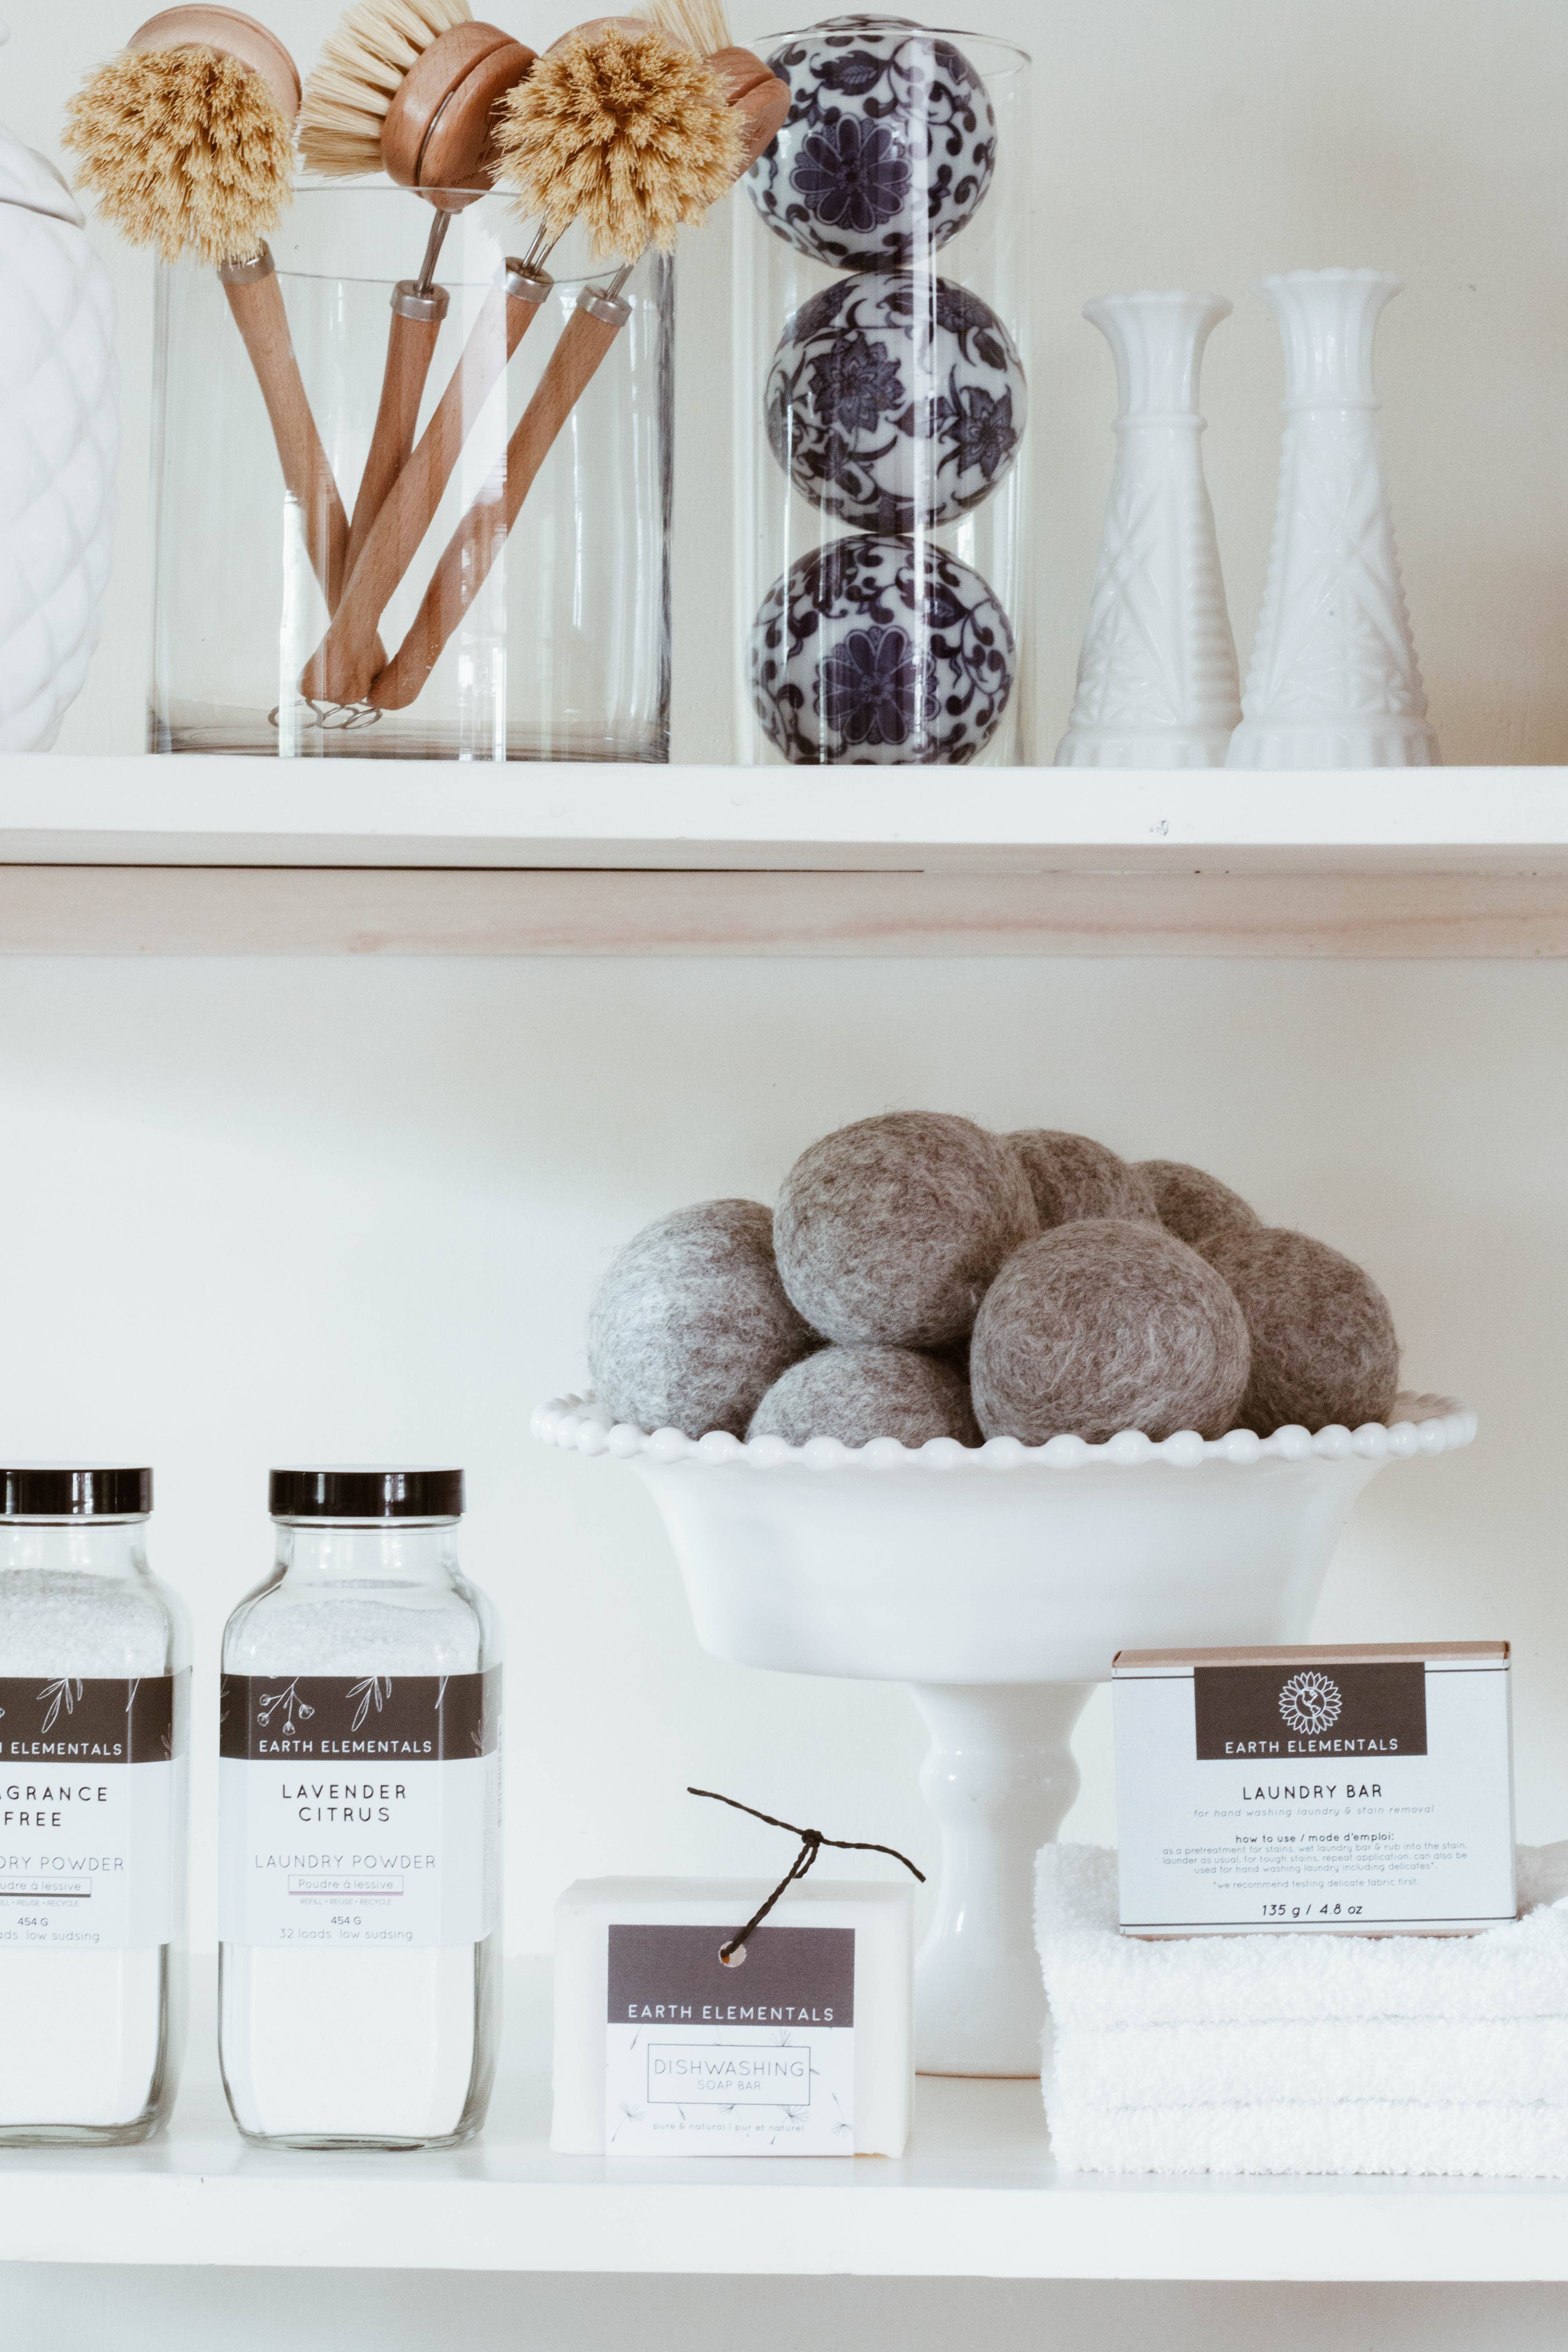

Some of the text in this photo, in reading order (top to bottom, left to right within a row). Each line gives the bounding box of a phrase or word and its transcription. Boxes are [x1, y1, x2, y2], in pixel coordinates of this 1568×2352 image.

[11, 1742, 122, 1755] ELEMENTALS
[260, 1740, 432, 1753] EARTH ELEMENTALS
[1225, 1739, 1397, 1753] EARTH ELEMENTALS
[283, 1784, 405, 1799] LAVENDER
[1243, 1784, 1381, 1800] LAUNDRY BAR
[299, 1807, 389, 1822] CITRUS
[1246, 1808, 1292, 1818] washing
[1297, 1807, 1339, 1817] laundry
[1357, 1806, 1384, 1815] stain
[1389, 1805, 1434, 1813] removal
[5, 1811, 61, 1826] FREE
[1308, 1833, 1339, 1842] mode
[1344, 1832, 1394, 1842] d'emploi:
[1185, 1846, 1246, 1855] pretreatment
[1317, 1844, 1352, 1853] laundry
[41, 1857, 123, 1871] POWDER
[256, 1855, 435, 1869] LAUNDRY POWDER
[1260, 1855, 1287, 1864] tough
[1323, 1855, 1352, 1863] repeat
[1263, 1864, 1301, 1874] washing
[1304, 1864, 1339, 1873] laundry
[1343, 1863, 1385, 1872] including
[42, 1881, 81, 1891] lessive
[299, 1879, 339, 1889] Poudre
[354, 1880, 393, 1889] lessive
[1233, 1880, 1289, 1889] recommend
[1292, 1880, 1324, 1889] testing
[1263, 1904, 1286, 1916] 135
[1292, 1907, 1300, 1918] g
[1319, 1904, 1341, 1915] 4.8
[1348, 1906, 1363, 1914] oz
[18, 1918, 48, 1926] 454 G
[331, 1916, 361, 1925] 454 G
[27, 1931, 47, 1940] low
[52, 1931, 100, 1943] sudsing
[280, 1928, 412, 1941] 32 loads low sudsing
[628, 2004, 833, 2021] EARTH ELEMENTALS
[655, 2059, 804, 2076] DISHWASHING
[698, 2080, 760, 2090] SOAP BAR
